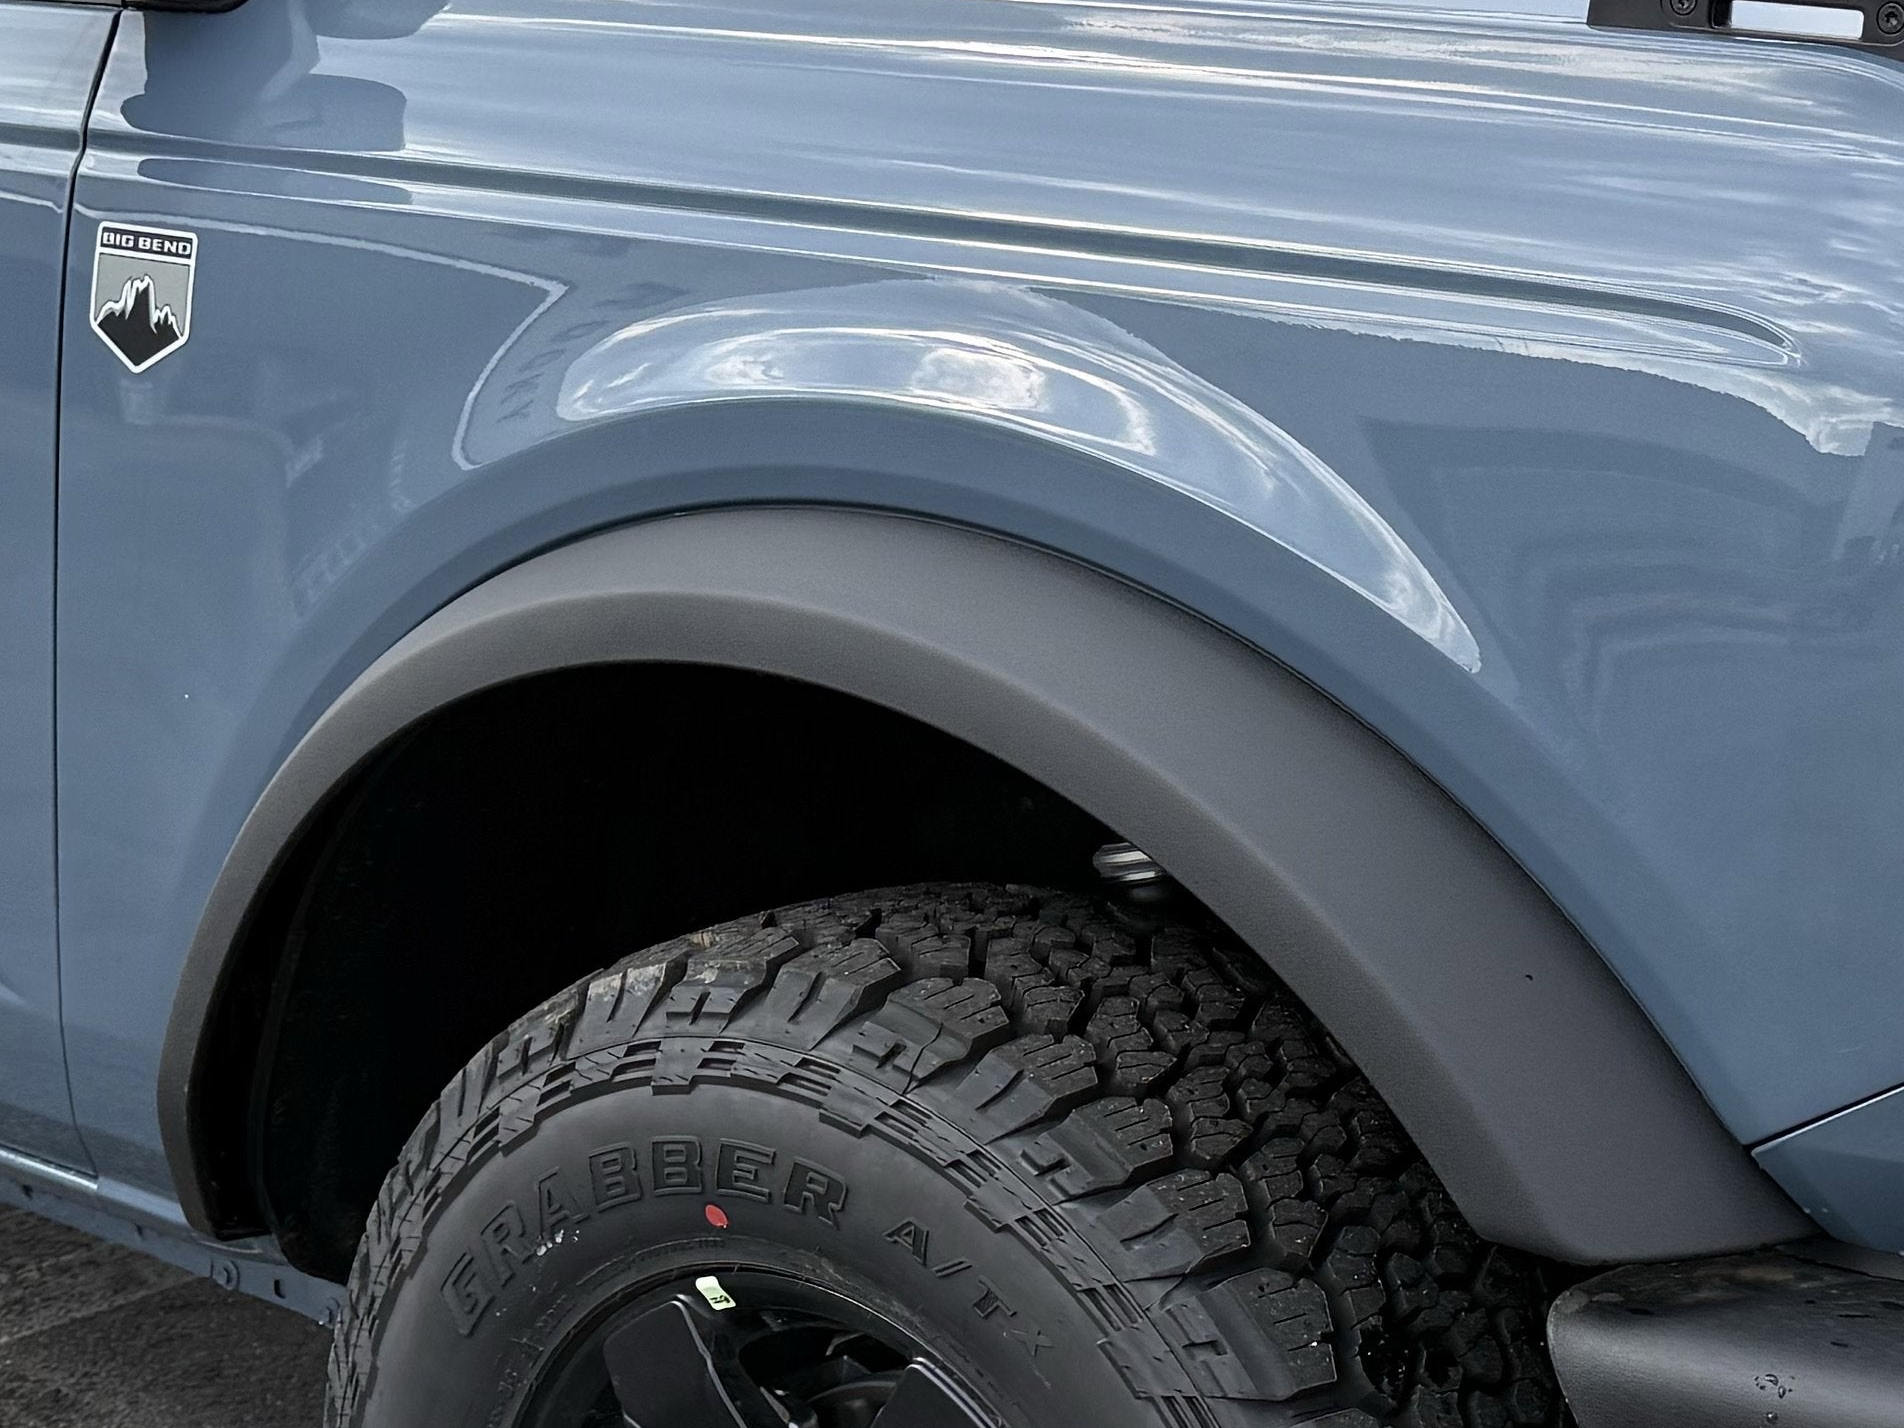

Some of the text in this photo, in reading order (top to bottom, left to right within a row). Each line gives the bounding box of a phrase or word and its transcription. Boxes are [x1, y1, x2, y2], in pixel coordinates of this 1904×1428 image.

[102, 232, 191, 255] BIG BEND
[439, 1134, 850, 1339] GRABBER
